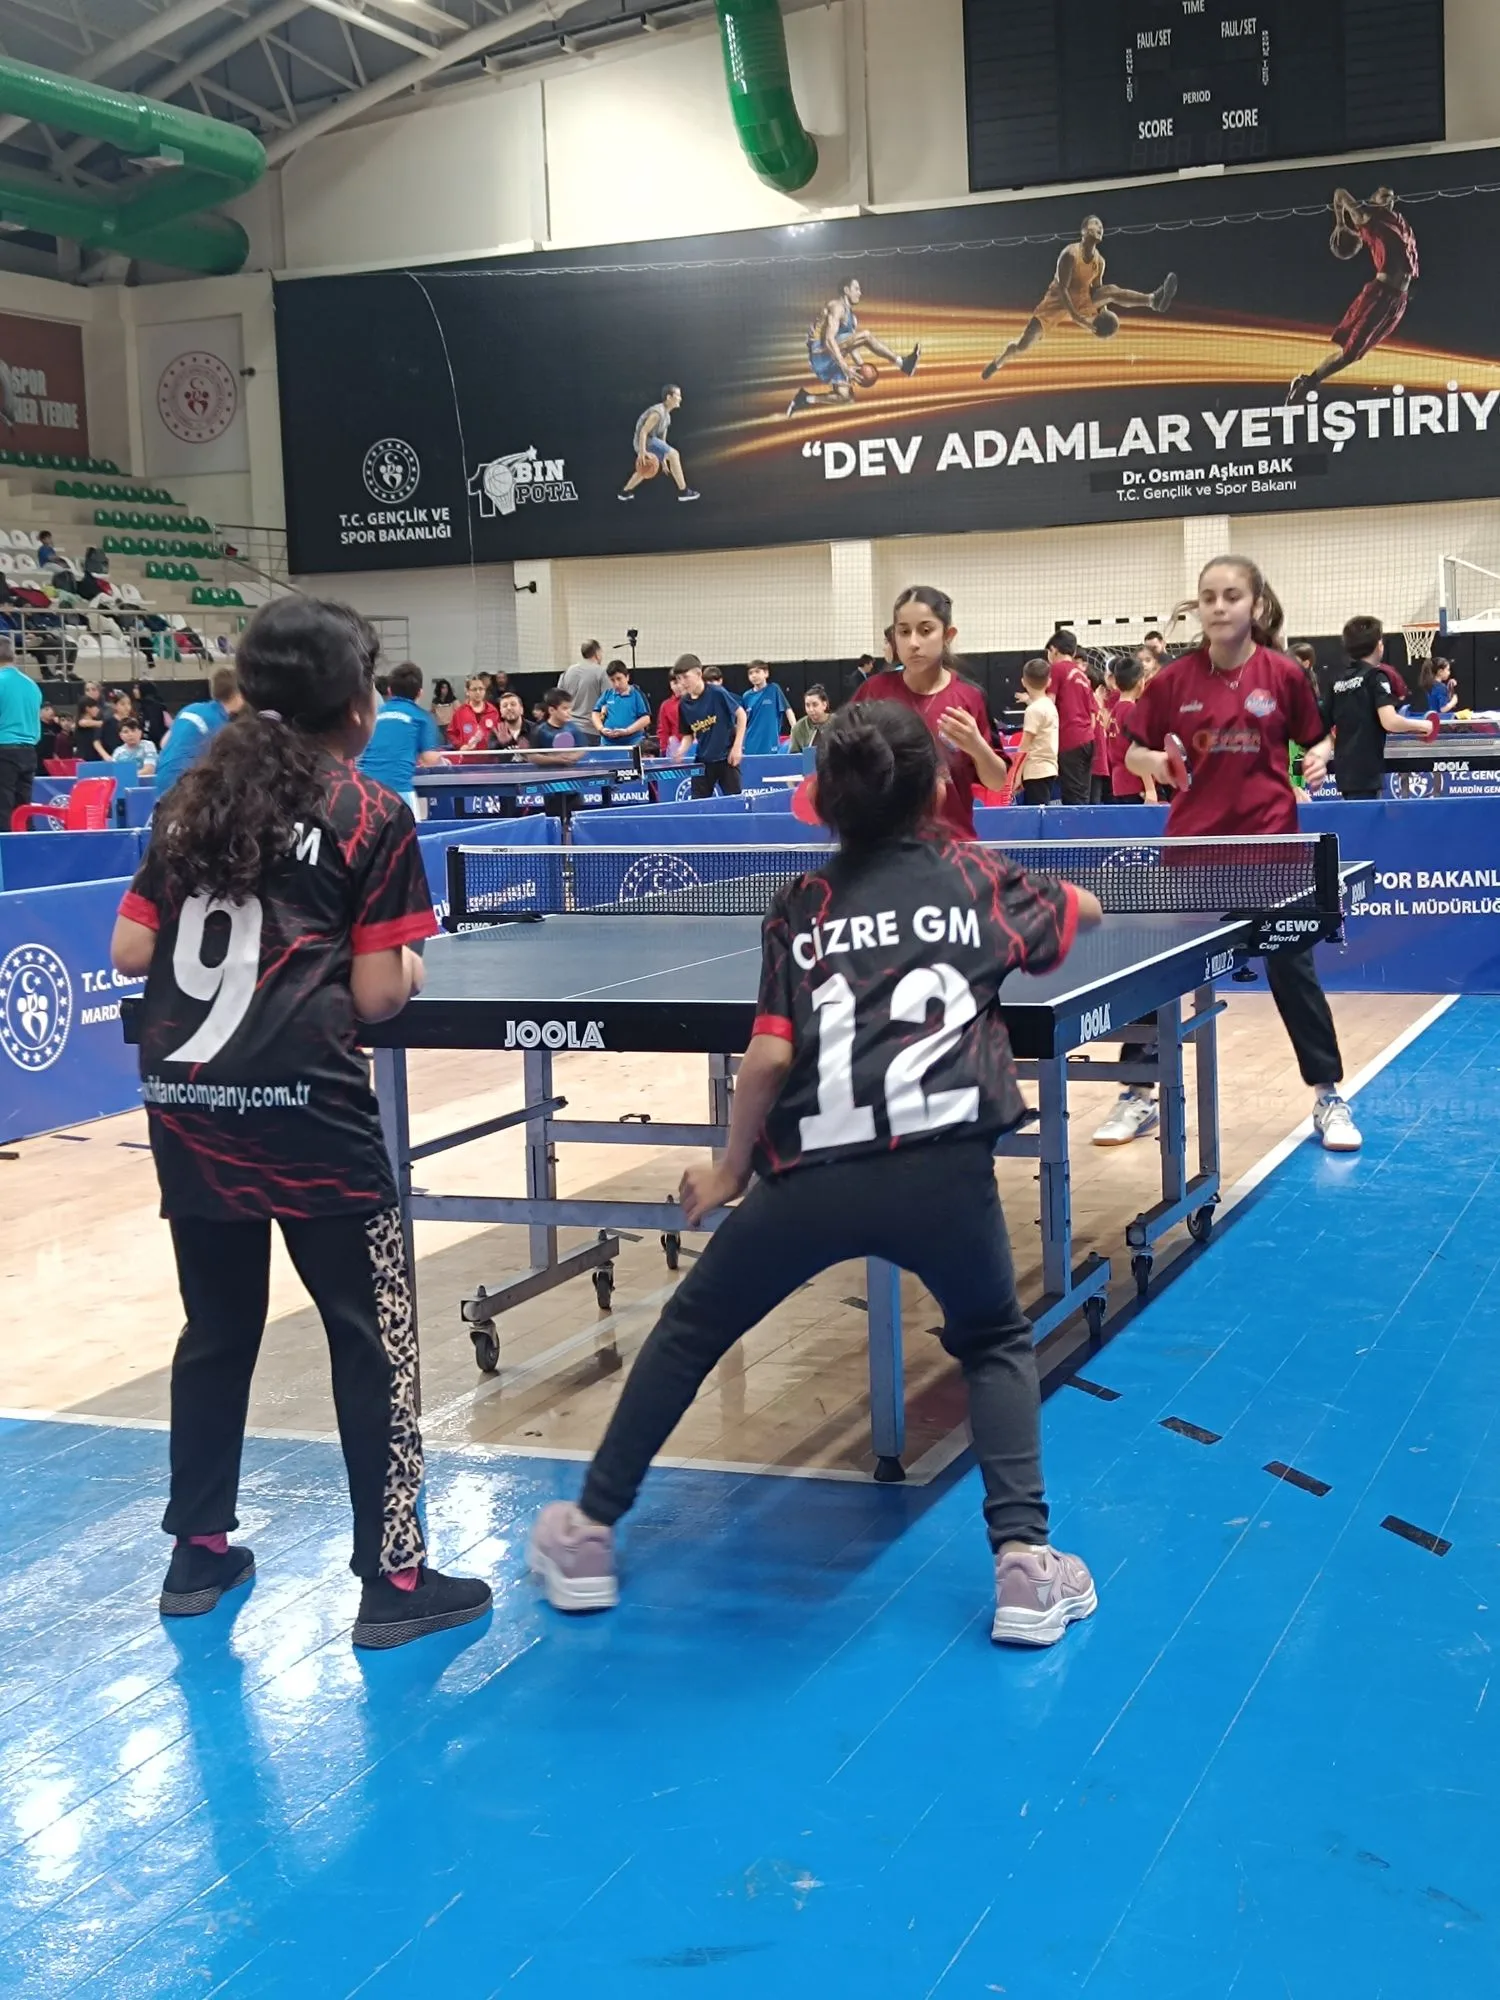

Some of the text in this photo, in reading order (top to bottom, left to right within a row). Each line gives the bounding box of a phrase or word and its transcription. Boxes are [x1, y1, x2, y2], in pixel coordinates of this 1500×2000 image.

[1182, 0, 1205, 15] TIME
[1221, 18, 1257, 38] FAUL/SET
[1137, 29, 1172, 49] FAUL/SET
[1183, 90, 1211, 104] PERIOD
[1138, 118, 1173, 139] SCORE
[1222, 108, 1258, 130] SCORE
[935, 414, 1192, 472] ADAMLAR
[1200, 380, 1500, 453] YETİŞTİRİY
[1122, 458, 1293, 485] Dr. Osman Aşkın BAK
[516, 481, 579, 504] POTA
[1116, 479, 1297, 501] T.C. Gençlik ve Spor Bakanı
[339, 506, 450, 527] T.C. GENÇLİK VE
[340, 525, 451, 545] SPOR BAKANLIĞI
[1433, 761, 1469, 772] JOOLA
[1449, 771, 1470, 780] T.C.
[583, 794, 602, 803] SPO
[1449, 785, 1483, 794] MARDİN
[1374, 869, 1500, 890] POR BAKANL
[1351, 897, 1500, 916] SPOR İL MÜDÜRLÜĞ
[1276, 920, 1319, 932] GEWO
[791, 905, 981, 971] CİZRE GM
[1259, 942, 1280, 951] Cup
[1268, 934, 1300, 942] World
[81, 969, 112, 993] T.C.
[163, 893, 264, 1063] 9
[81, 999, 122, 1025] MARDİ
[1080, 1003, 1111, 1043] JOOLA
[504, 1020, 605, 1049] JOOLA
[800, 962, 980, 1152] 12
